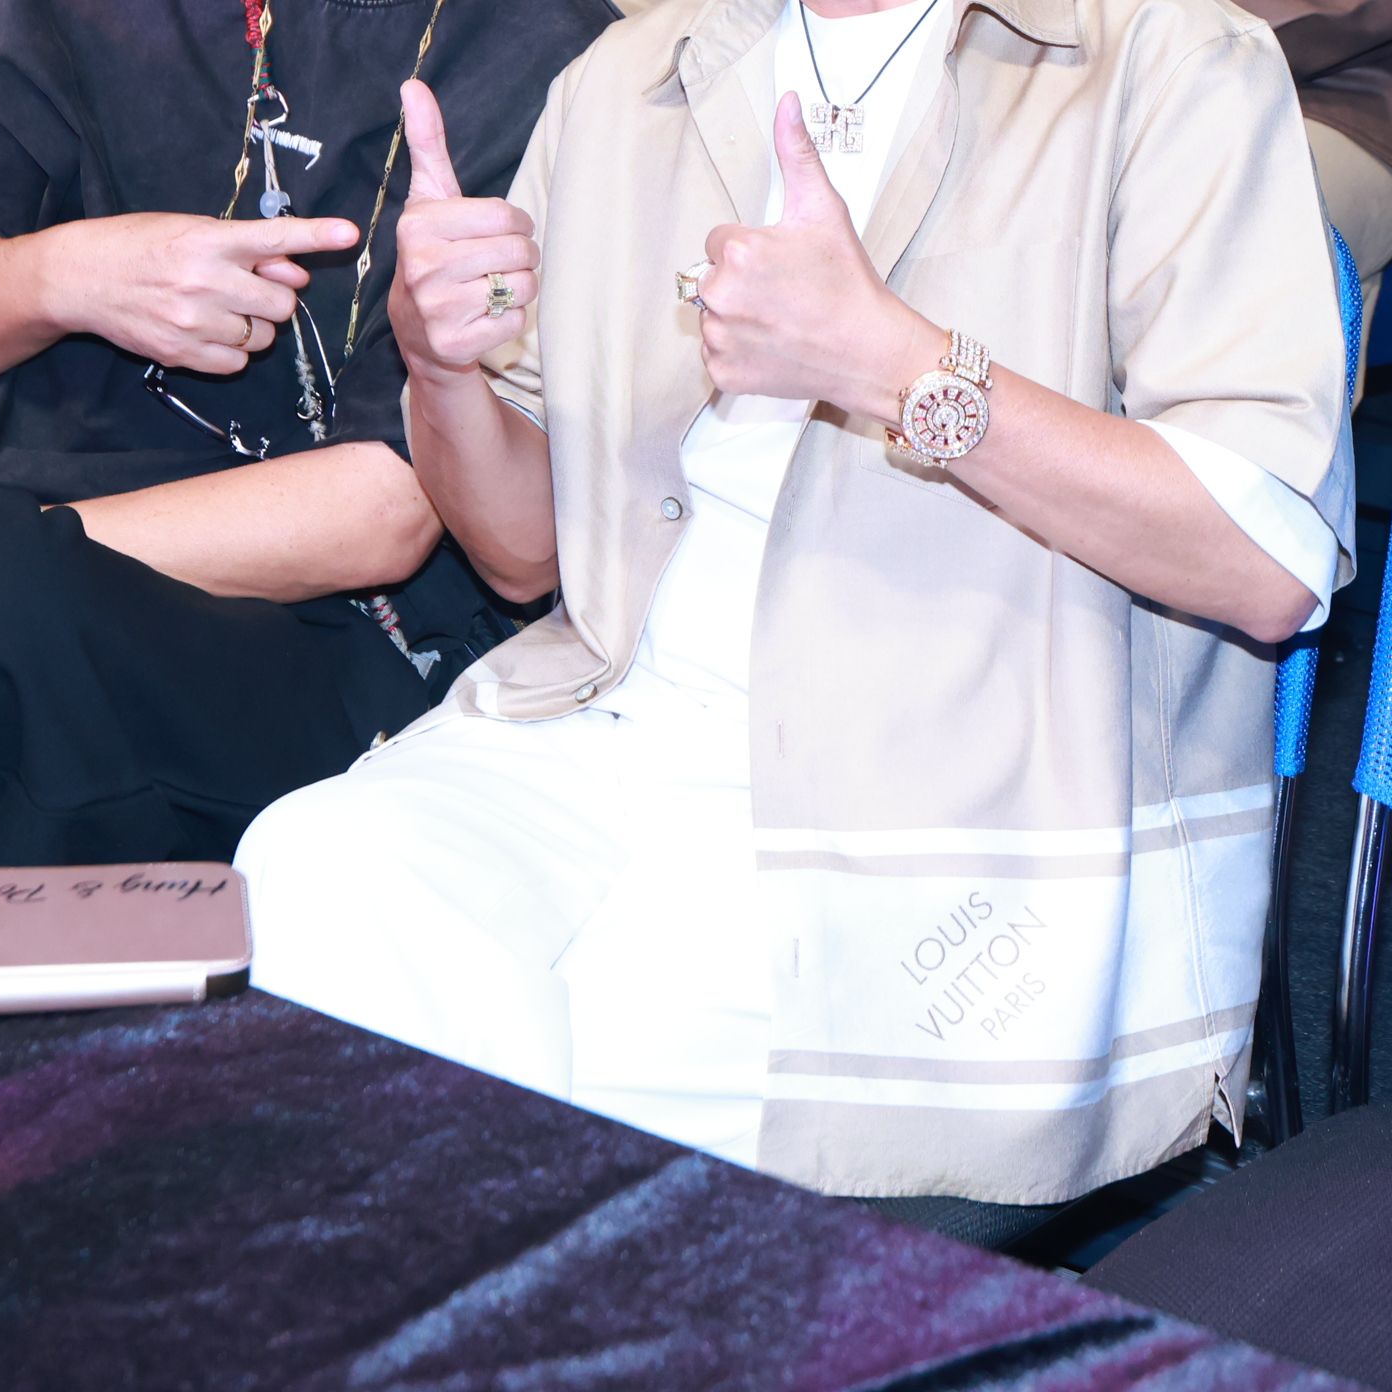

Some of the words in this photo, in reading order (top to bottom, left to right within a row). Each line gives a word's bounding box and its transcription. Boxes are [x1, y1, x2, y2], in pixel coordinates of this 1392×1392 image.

[900, 891, 993, 986] LOUIS
[915, 905, 1048, 1042] VUITTON
[979, 972, 1047, 1041] PARIS
